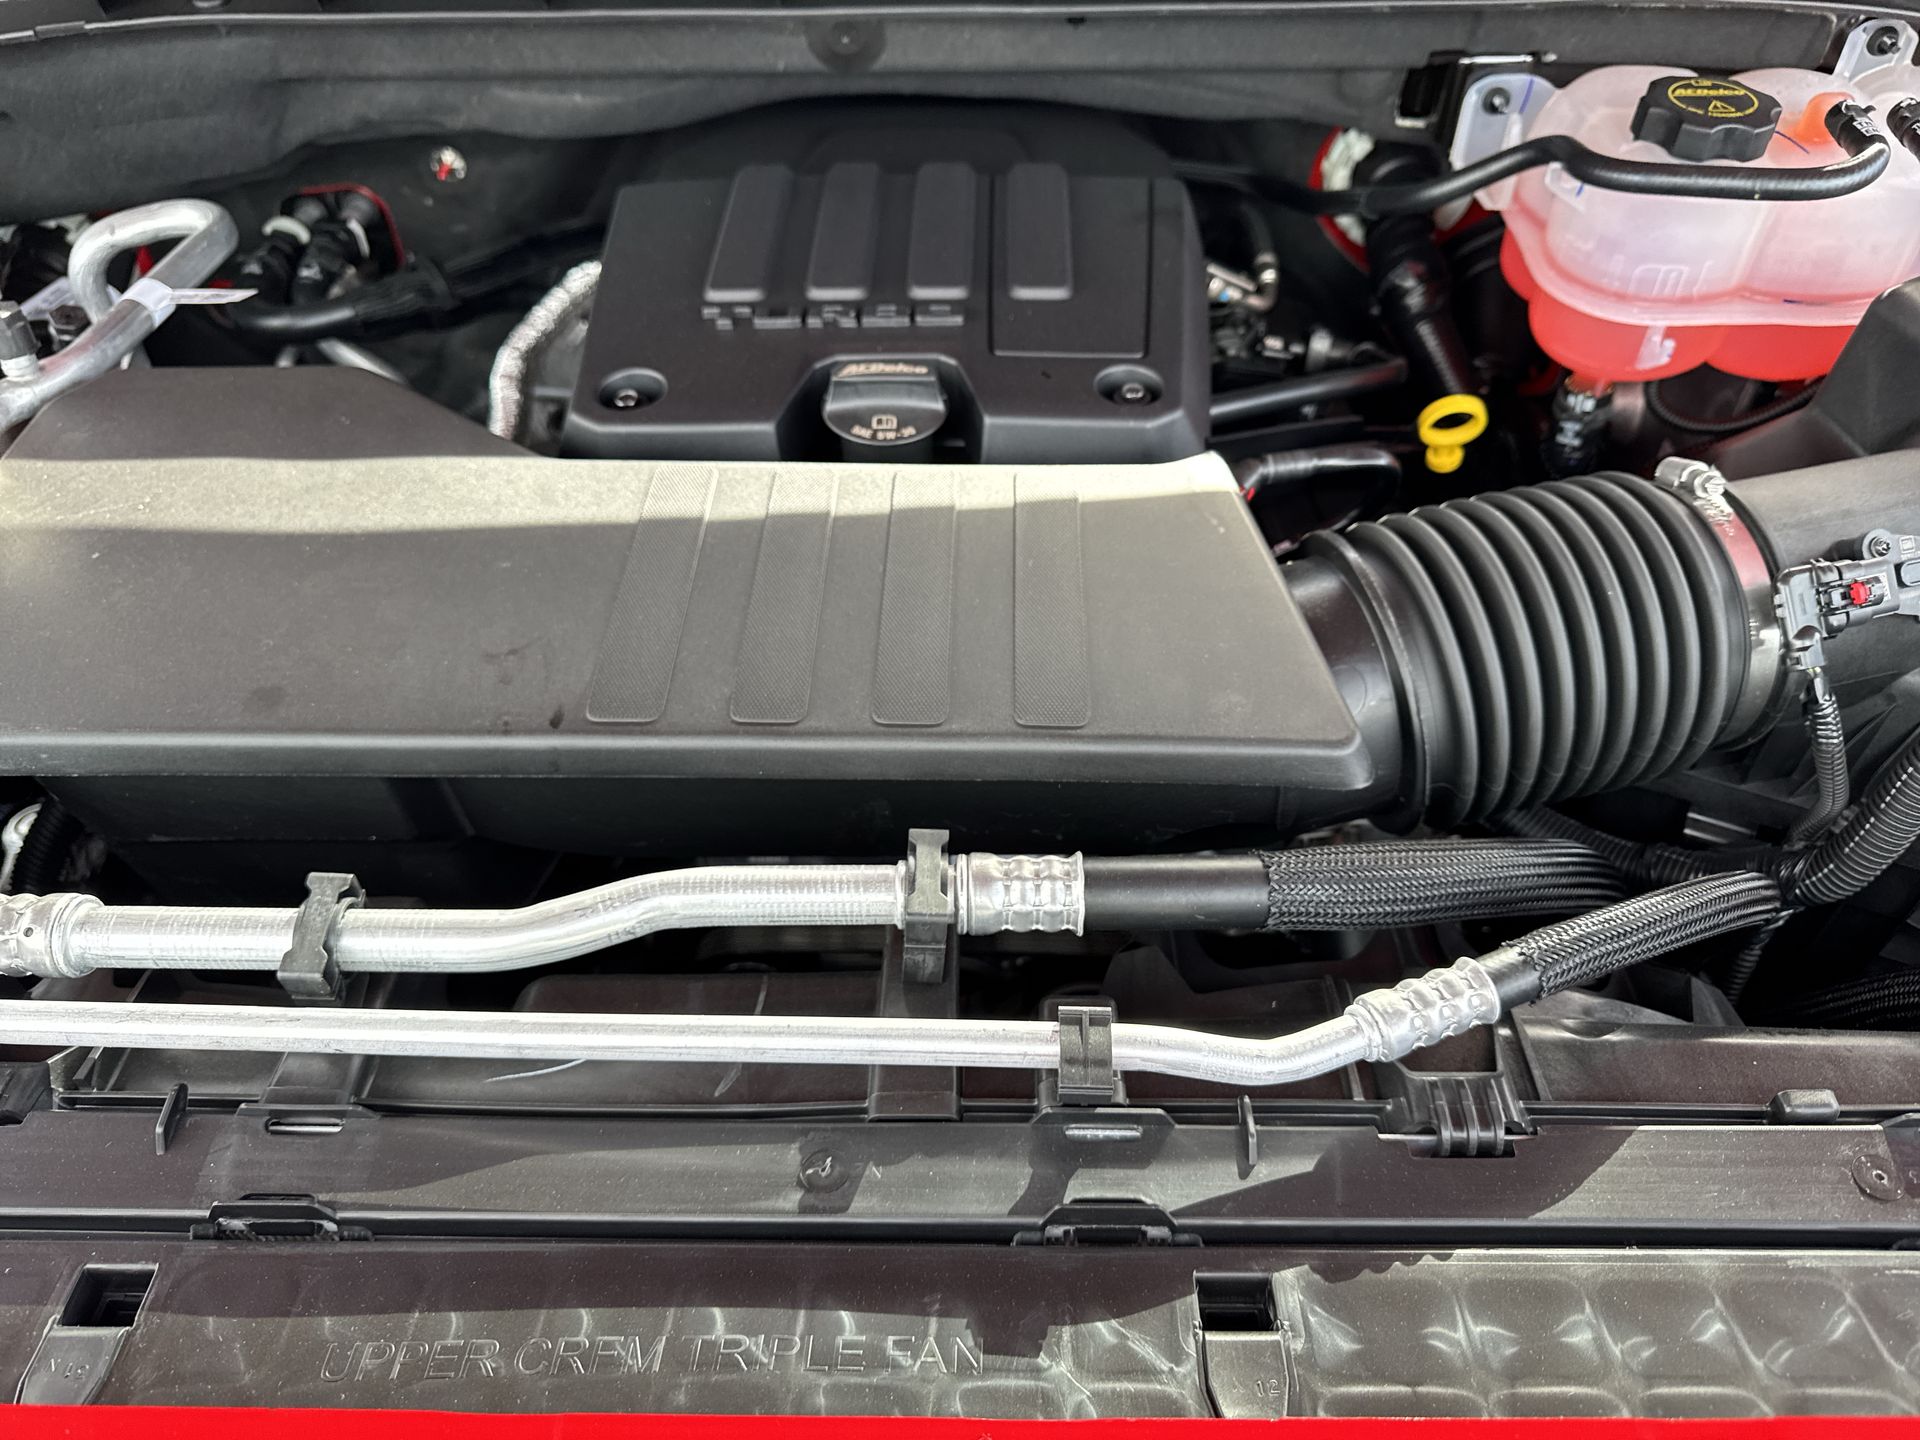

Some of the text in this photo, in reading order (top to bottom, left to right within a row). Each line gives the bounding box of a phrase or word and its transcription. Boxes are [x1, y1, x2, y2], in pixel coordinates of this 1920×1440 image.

[1672, 88, 1746, 98] ACDelco
[838, 362, 929, 378] ACDelco
[320, 1338, 500, 1382] UPPER
[682, 1334, 866, 1374] TRIPLE
[884, 1335, 984, 1376] FAN
[1256, 1378, 1281, 1398] 12
